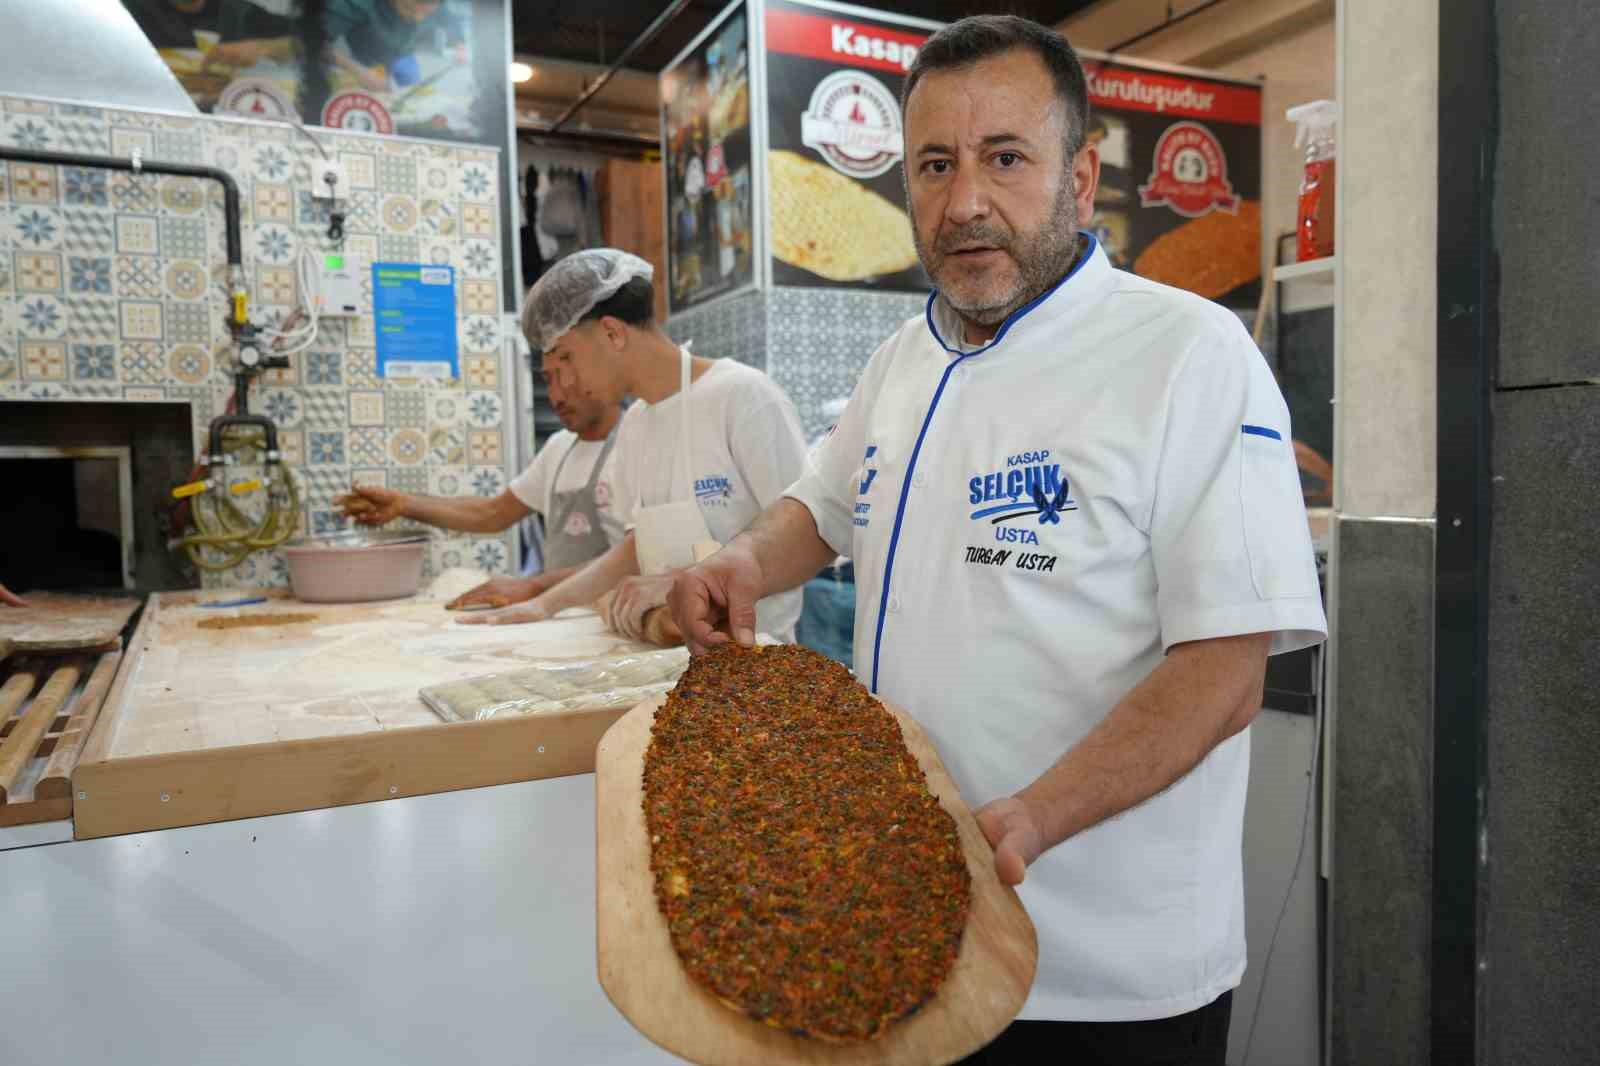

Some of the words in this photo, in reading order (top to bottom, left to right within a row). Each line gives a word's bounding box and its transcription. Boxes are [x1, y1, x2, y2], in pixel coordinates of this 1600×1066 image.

[832, 24, 917, 71] Kasap
[1007, 450, 1050, 467] KASAP
[969, 464, 1060, 505] SELÇUK
[995, 527, 1039, 545] USTA
[965, 546, 1012, 567] TURGAY
[1016, 552, 1057, 572] USTA
